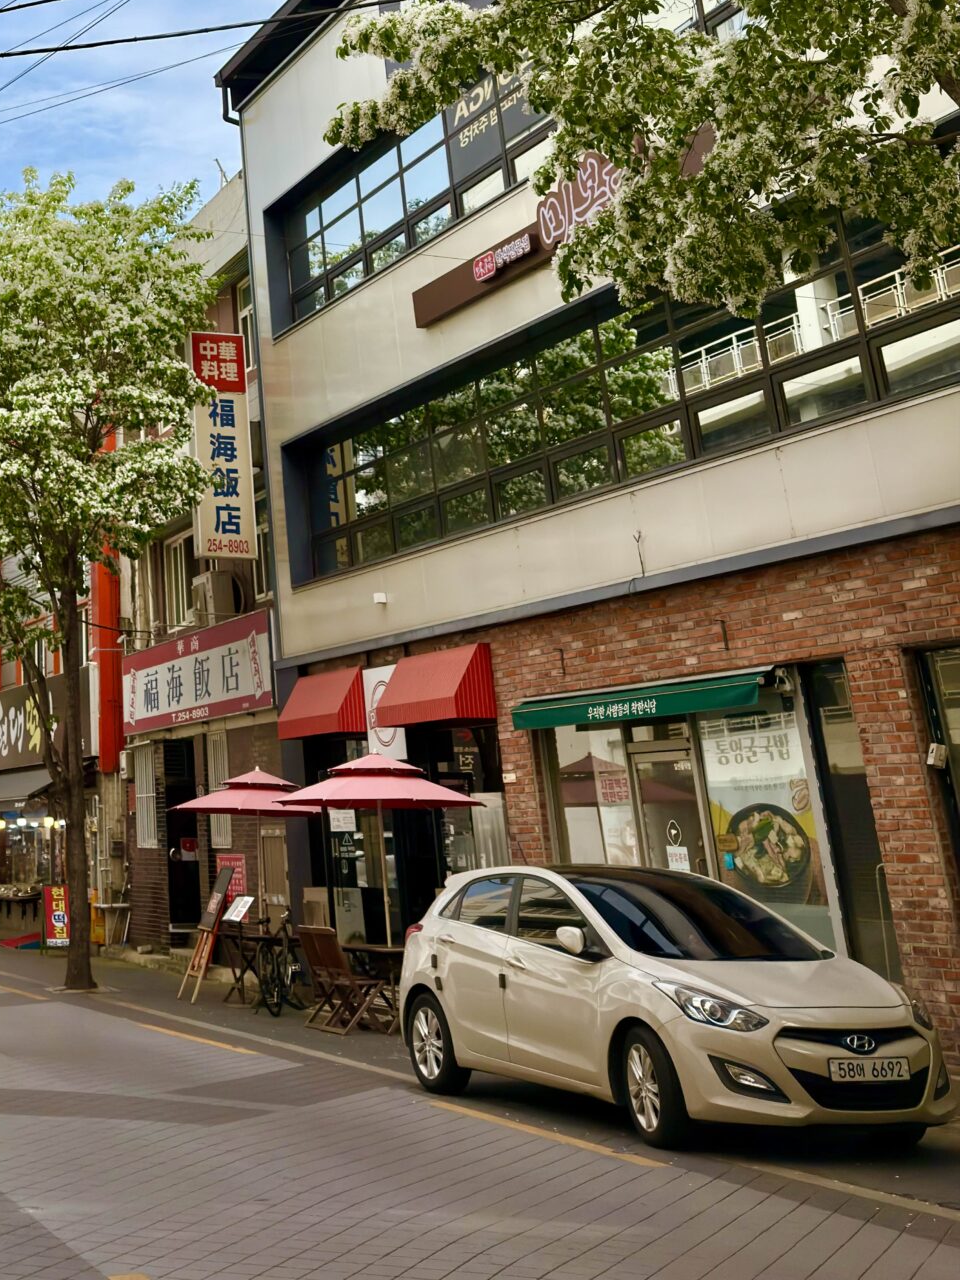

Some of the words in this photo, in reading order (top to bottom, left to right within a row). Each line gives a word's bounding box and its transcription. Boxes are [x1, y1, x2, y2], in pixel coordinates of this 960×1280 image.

[199, 340, 237, 361] 中華
[201, 360, 239, 382] 料理
[208, 398, 241, 535] 福海飯店
[207, 538, 250, 554] 254-8903
[143, 647, 240, 713] 福海飯店
[171, 707, 209, 723] T.254-8903
[587, 705, 605, 720] 우직한
[605, 702, 630, 718] 사람들의
[631, 698, 657, 715] 착한식당
[715, 732, 790, 766] 통영굴국밥
[837, 1061, 866, 1079] 58어
[871, 1060, 904, 1078] 6692
